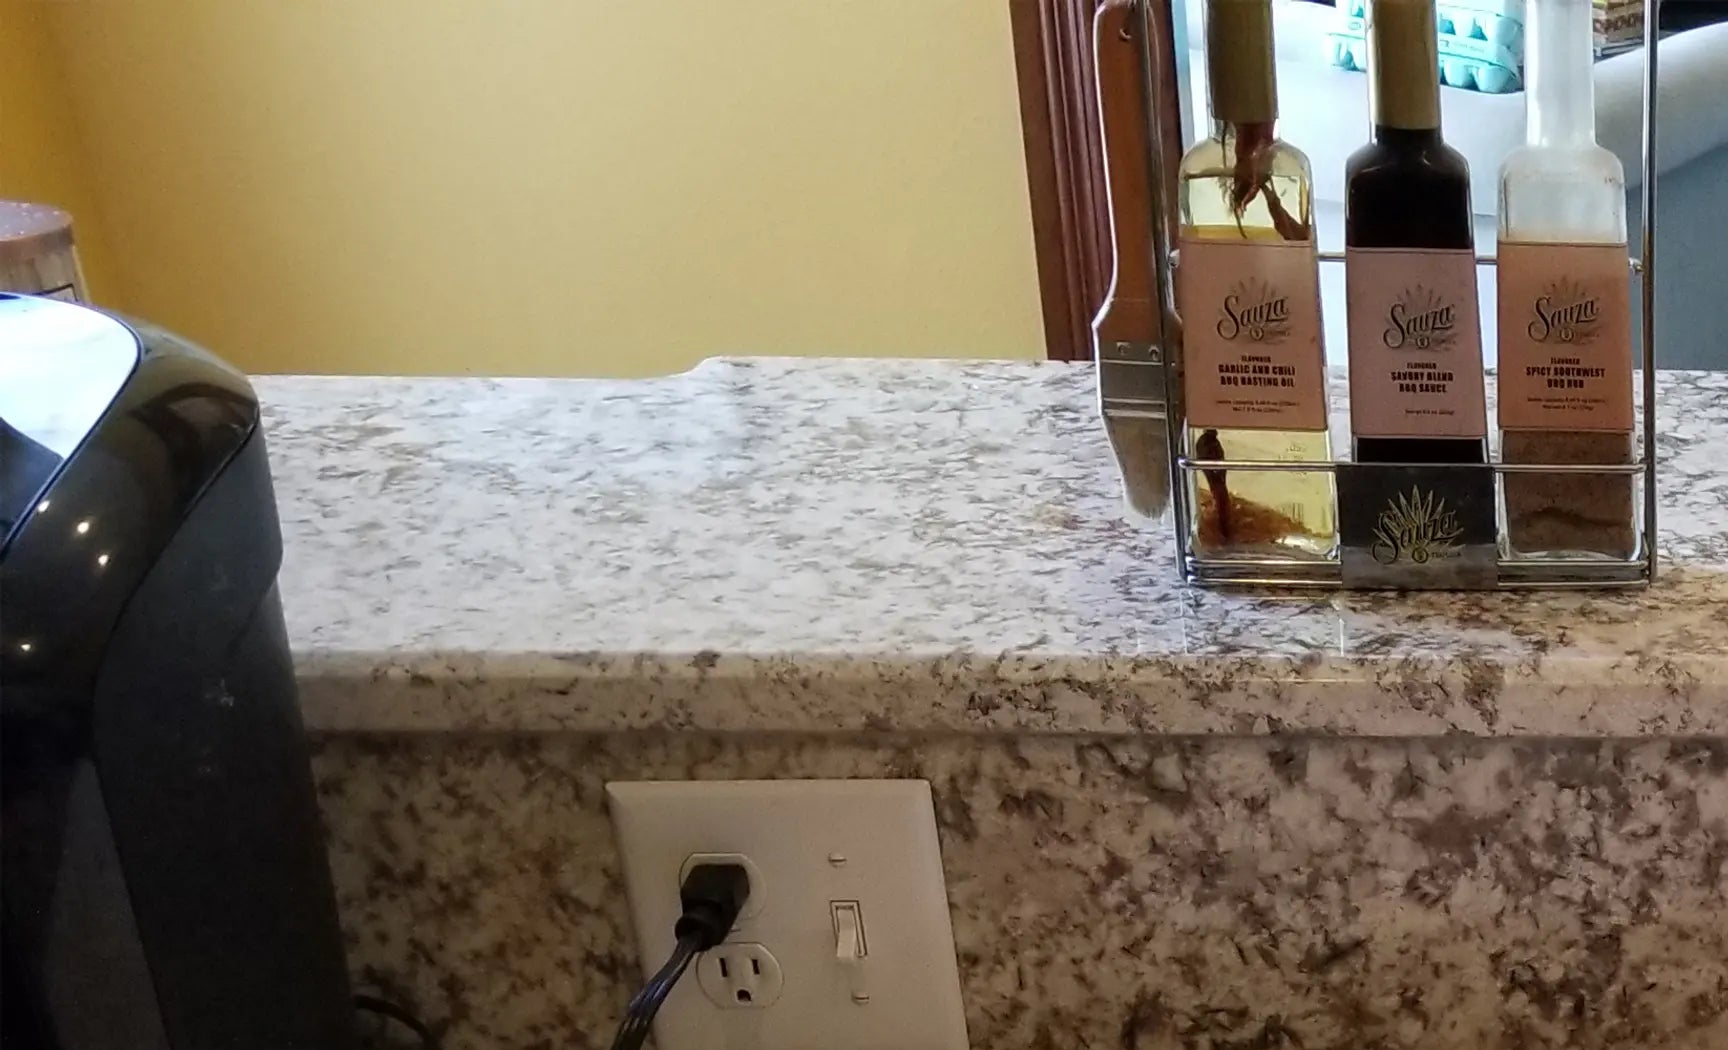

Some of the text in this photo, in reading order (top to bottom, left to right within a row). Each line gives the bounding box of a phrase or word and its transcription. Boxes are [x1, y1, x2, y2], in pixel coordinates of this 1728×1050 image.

[1217, 295, 1290, 341] Sauza
[1527, 296, 1601, 342] Sauza
[1383, 303, 1456, 349] Sauza
[1218, 364, 1296, 376] GARLIC AND CHILI
[1526, 366, 1606, 378] SPICY SOUTHWEST
[1220, 376, 1295, 388] BBQ BASTING OIL
[1390, 371, 1454, 382] SAVORY BLEND
[1399, 383, 1447, 393] BBQ SAUCE
[1547, 379, 1585, 389] BBQ RUB
[1371, 511, 1465, 565] Sauza
